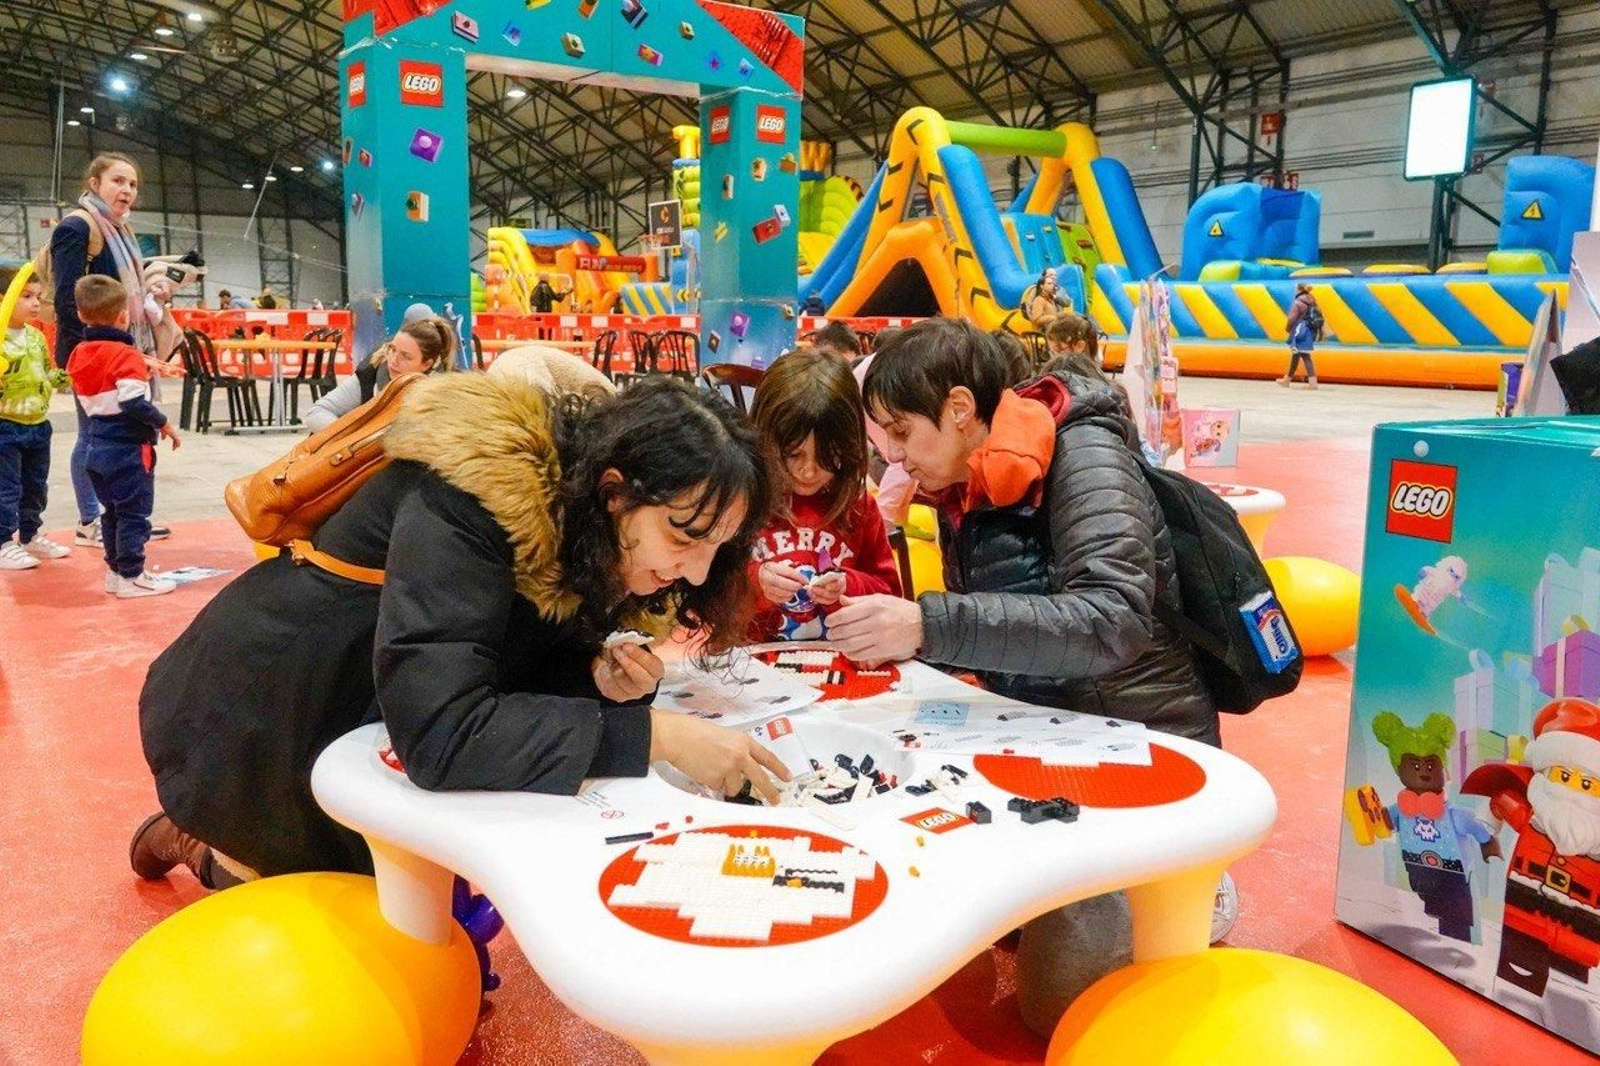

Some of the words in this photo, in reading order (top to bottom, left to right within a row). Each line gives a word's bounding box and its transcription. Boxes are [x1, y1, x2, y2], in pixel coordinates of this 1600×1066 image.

[402, 74, 441, 94] LEGO
[759, 116, 785, 132] LEGO
[1391, 482, 1452, 518] LEGO
[751, 527, 854, 568] MERRY
